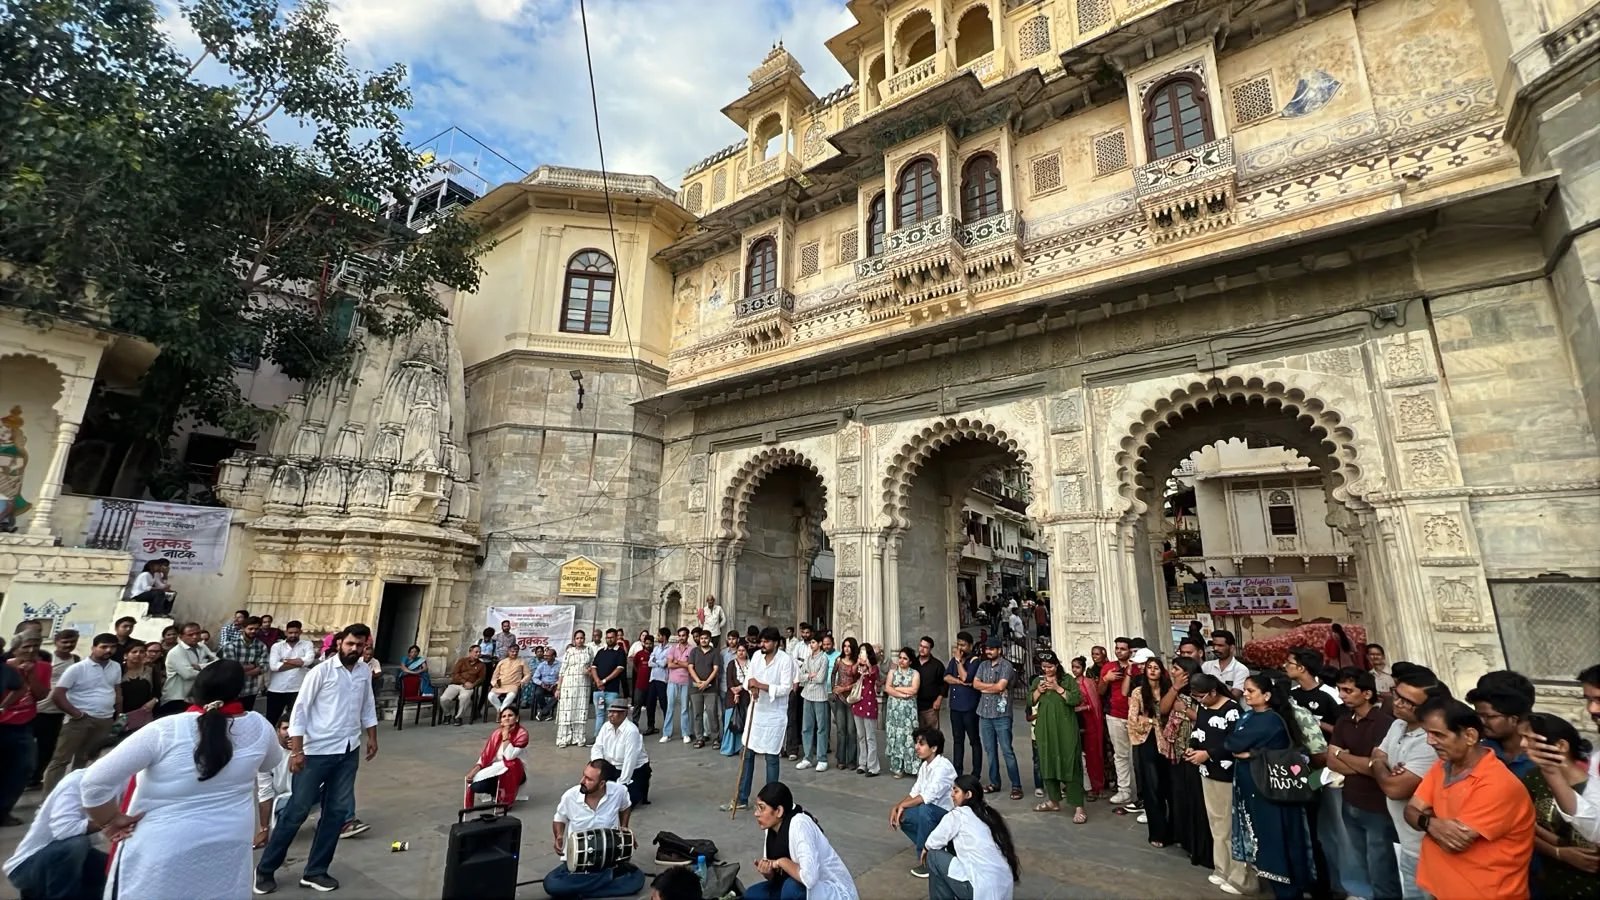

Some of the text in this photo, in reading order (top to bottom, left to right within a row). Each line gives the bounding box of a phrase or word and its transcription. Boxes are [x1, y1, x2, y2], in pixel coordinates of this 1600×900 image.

[161, 549, 197, 559] नाटक
[1268, 763, 1288, 777] It's
[1270, 776, 1303, 790] mine
